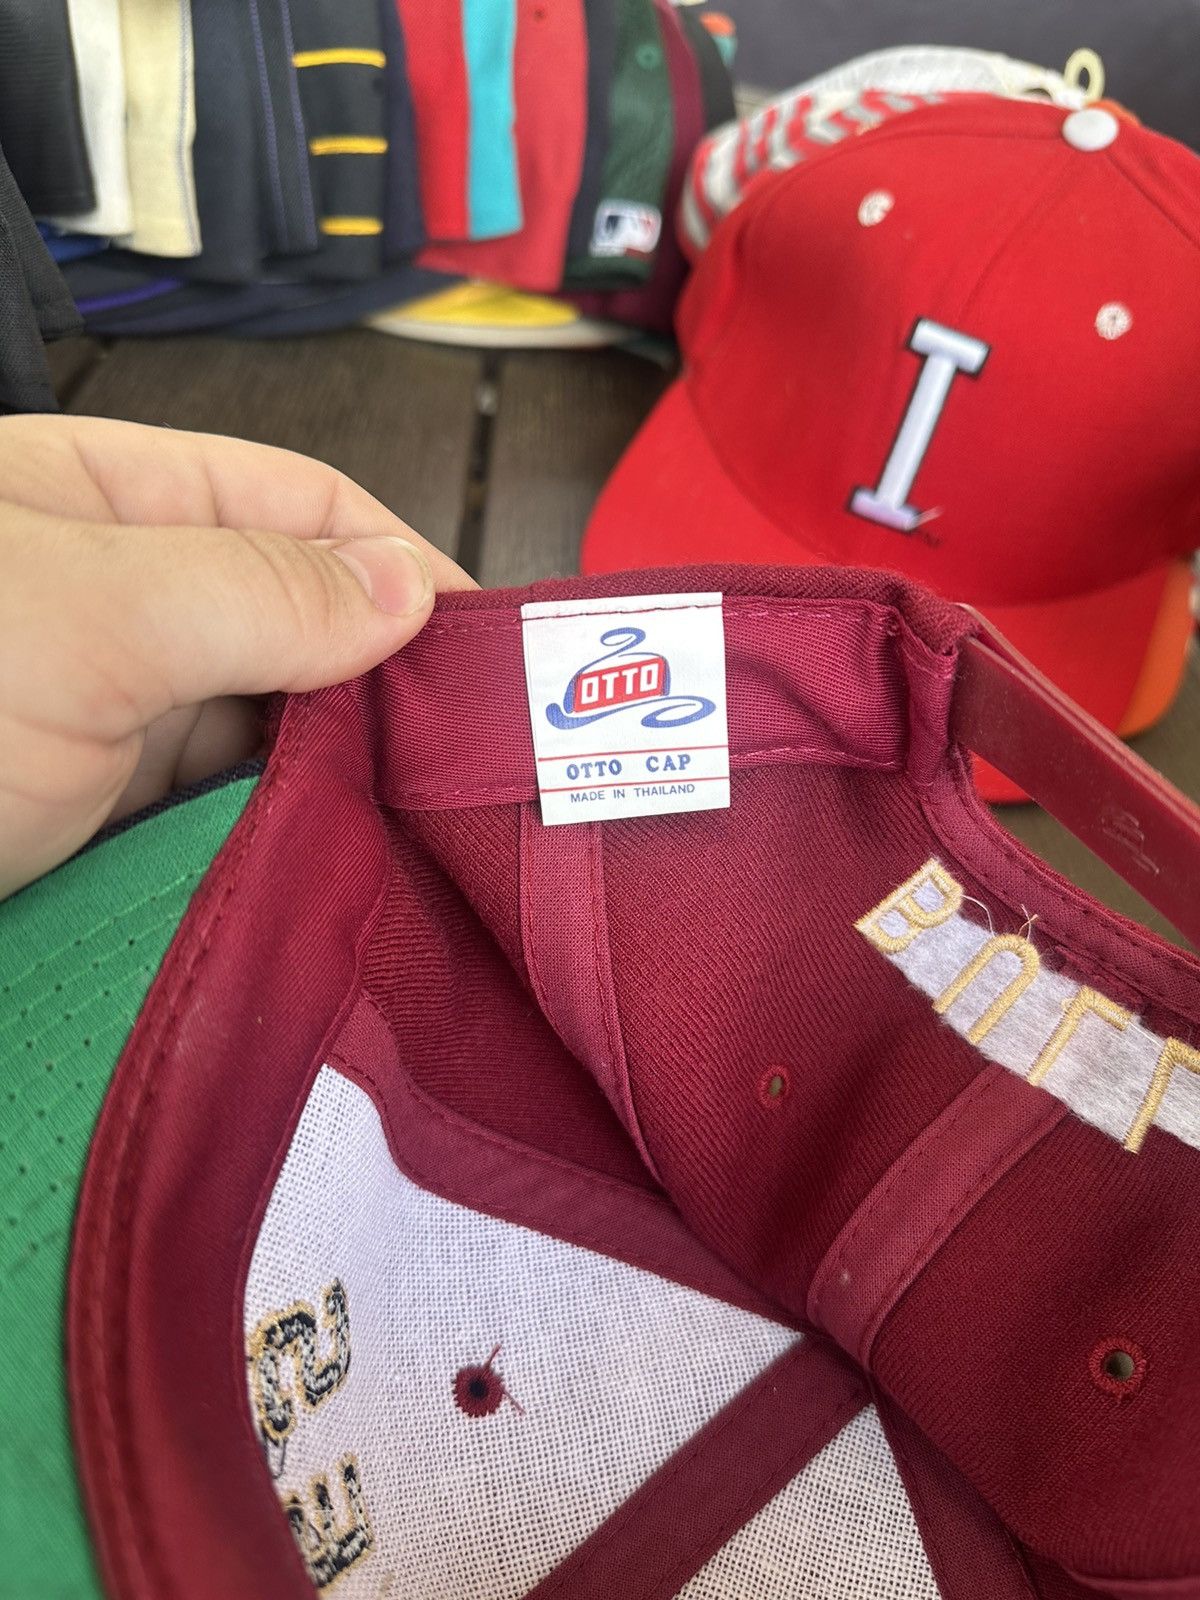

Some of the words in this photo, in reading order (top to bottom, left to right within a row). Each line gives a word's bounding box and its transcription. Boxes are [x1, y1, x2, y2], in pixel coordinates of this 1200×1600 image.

[847, 316, 992, 534] I
[580, 662, 659, 705] OTTO
[566, 758, 622, 780] OTTO
[645, 753, 692, 773] CAP
[570, 790, 606, 803] MADE
[613, 788, 626, 799] IN
[634, 783, 695, 798] THAILAND
